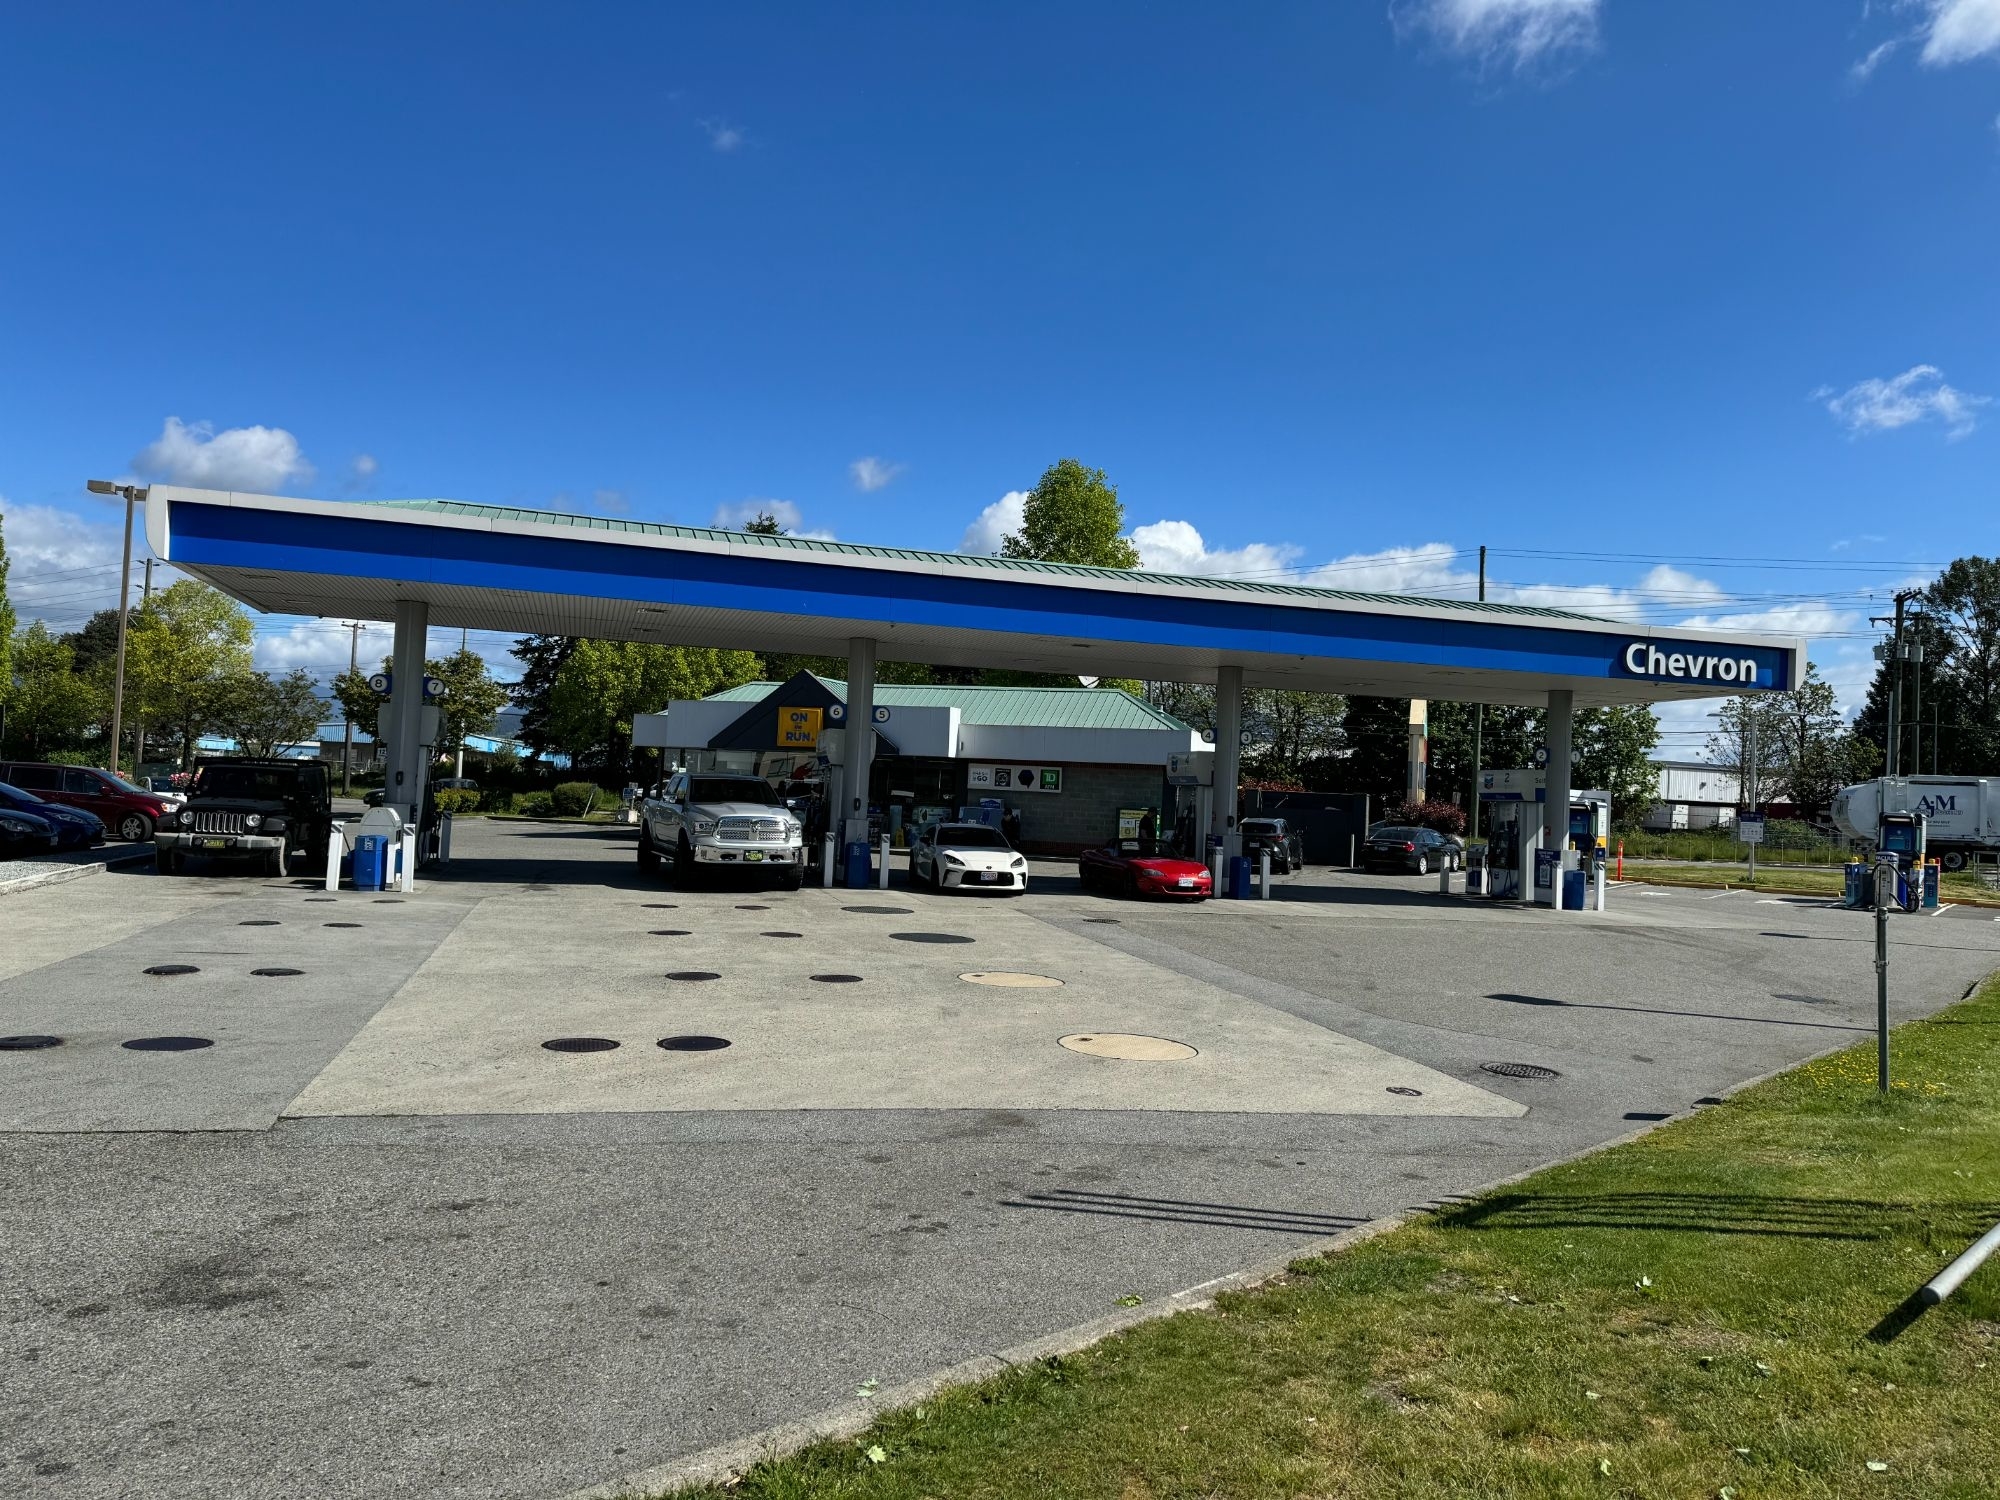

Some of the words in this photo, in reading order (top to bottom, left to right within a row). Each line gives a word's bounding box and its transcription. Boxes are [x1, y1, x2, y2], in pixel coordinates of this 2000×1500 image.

[1626, 642, 1757, 682] Chevron
[375, 679, 382, 688] 8
[432, 682, 439, 691] 7
[833, 707, 840, 716] 6
[879, 710, 885, 719] 5
[791, 712, 808, 722] ON
[1205, 731, 1211, 739] 4
[1243, 733, 1249, 742] 3
[1538, 751, 1544, 759] 2
[1044, 773, 1056, 782] TD
[1504, 773, 1510, 783] 2
